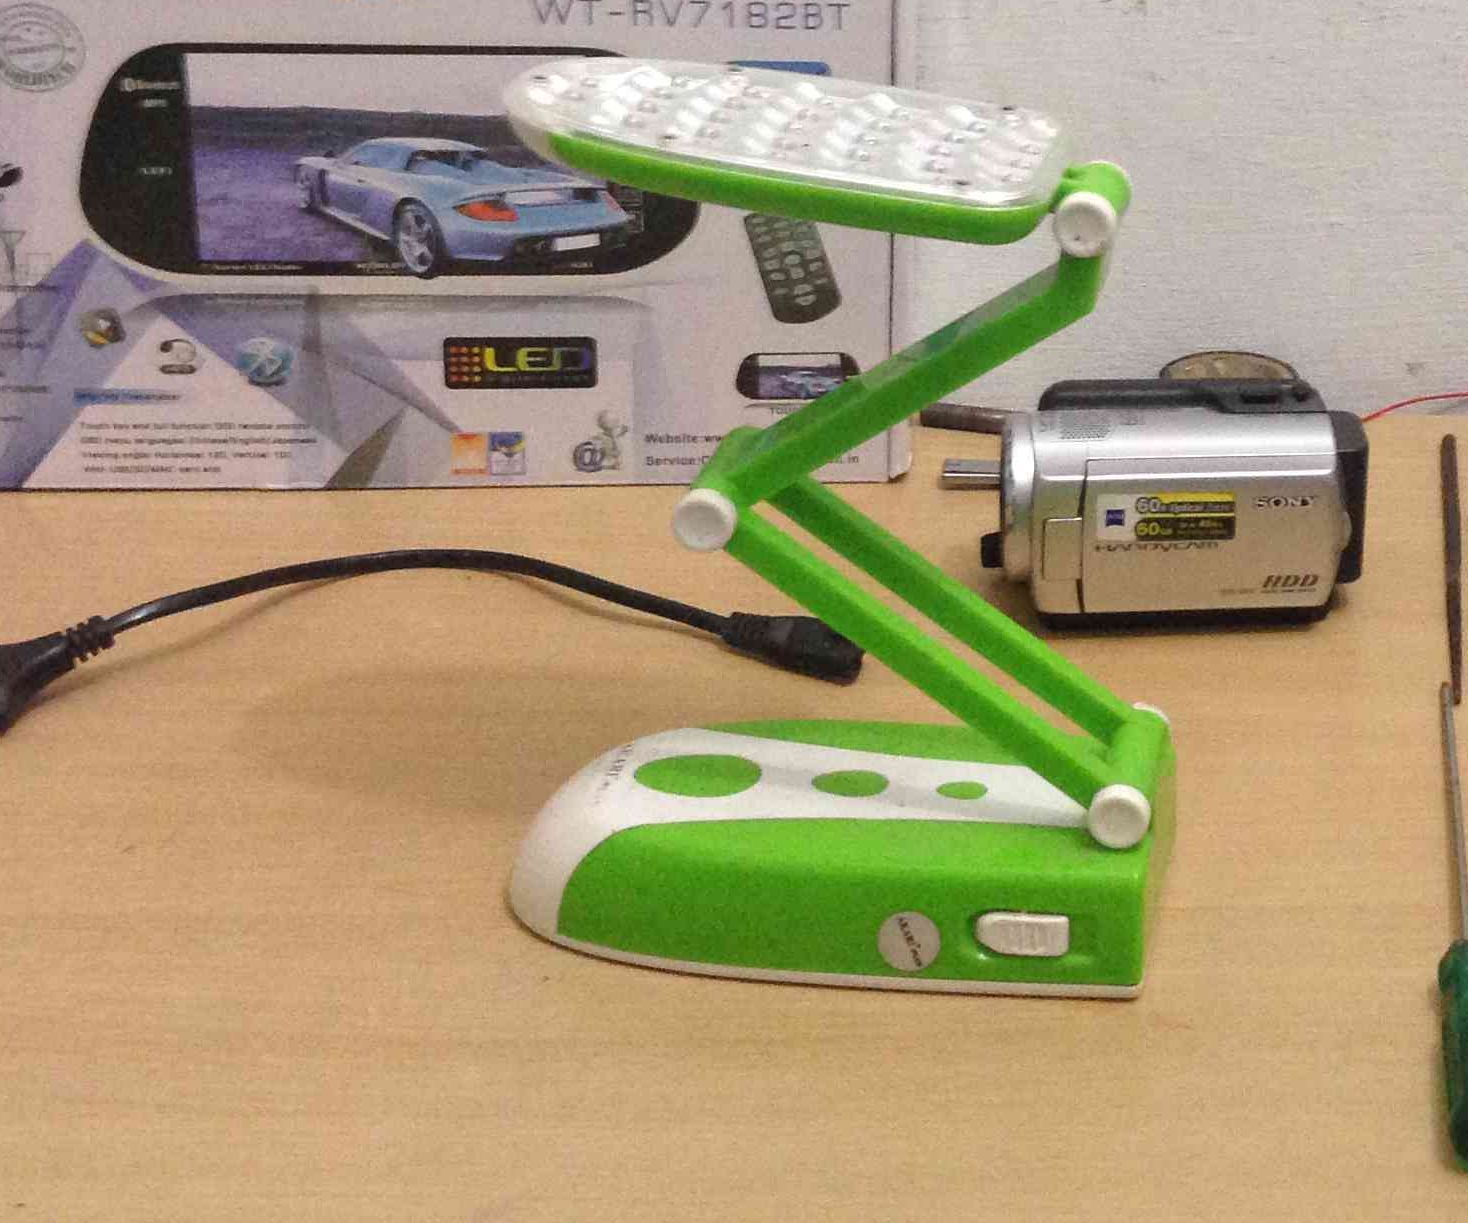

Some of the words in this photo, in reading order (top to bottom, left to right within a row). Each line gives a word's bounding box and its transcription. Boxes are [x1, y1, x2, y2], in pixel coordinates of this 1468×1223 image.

[484, 346, 590, 372] LED
[1253, 495, 1316, 509] SONY
[1262, 574, 1318, 588] HDD
